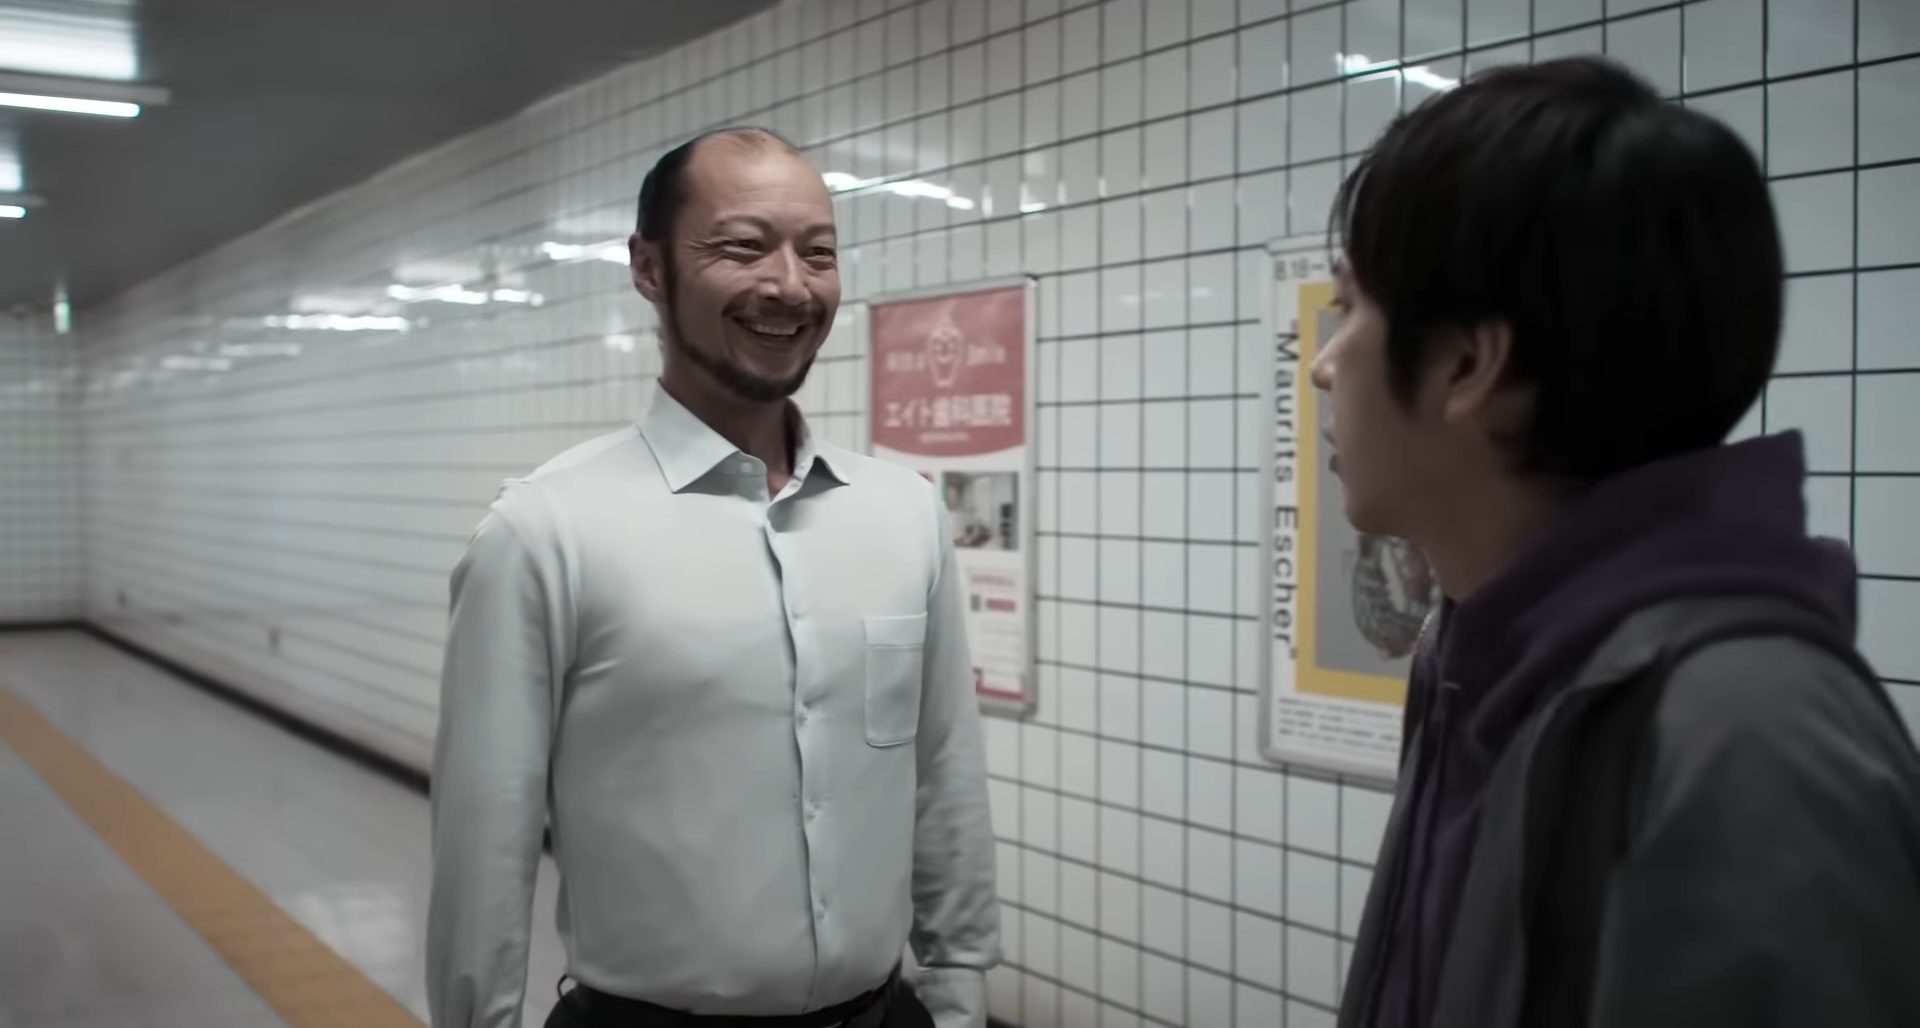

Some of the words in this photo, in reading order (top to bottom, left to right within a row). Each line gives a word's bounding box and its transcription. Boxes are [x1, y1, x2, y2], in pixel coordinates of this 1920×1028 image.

[884, 394, 1012, 427] エイト歯科医院
[1273, 505, 1299, 659] Escher"
